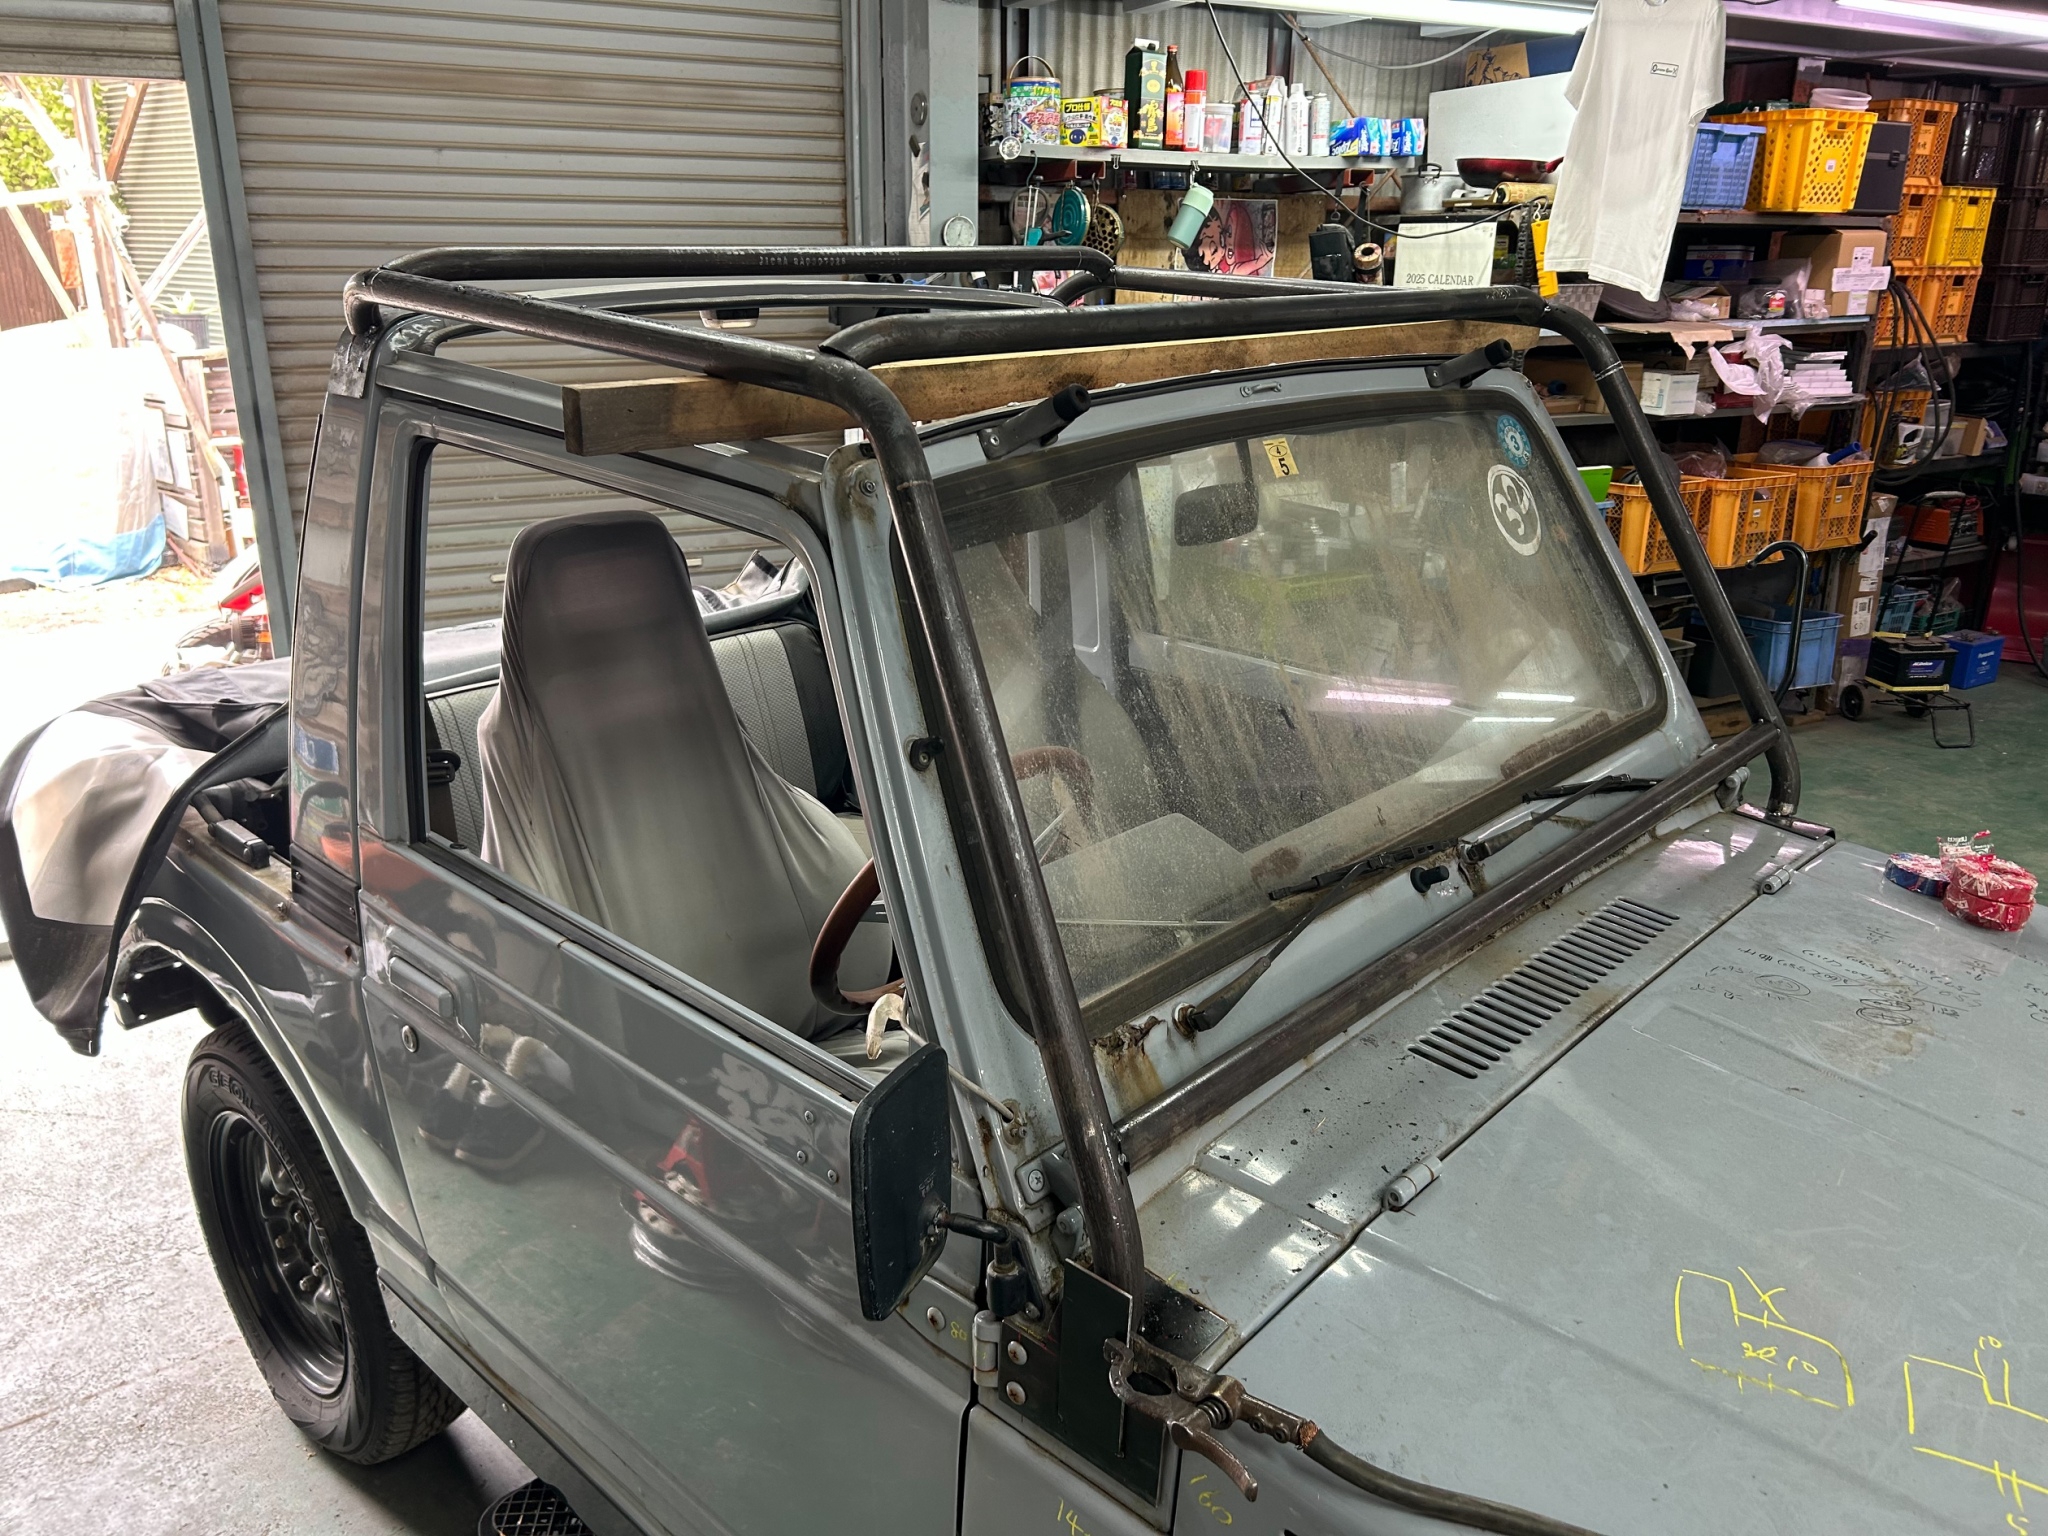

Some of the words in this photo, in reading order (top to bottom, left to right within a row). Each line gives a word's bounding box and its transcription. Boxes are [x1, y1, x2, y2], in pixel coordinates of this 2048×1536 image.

[1405, 273, 1426, 284] 2025
[1427, 273, 1475, 286] CALENDAR
[1510, 434, 1521, 452] 3
[1278, 457, 1290, 476] 5
